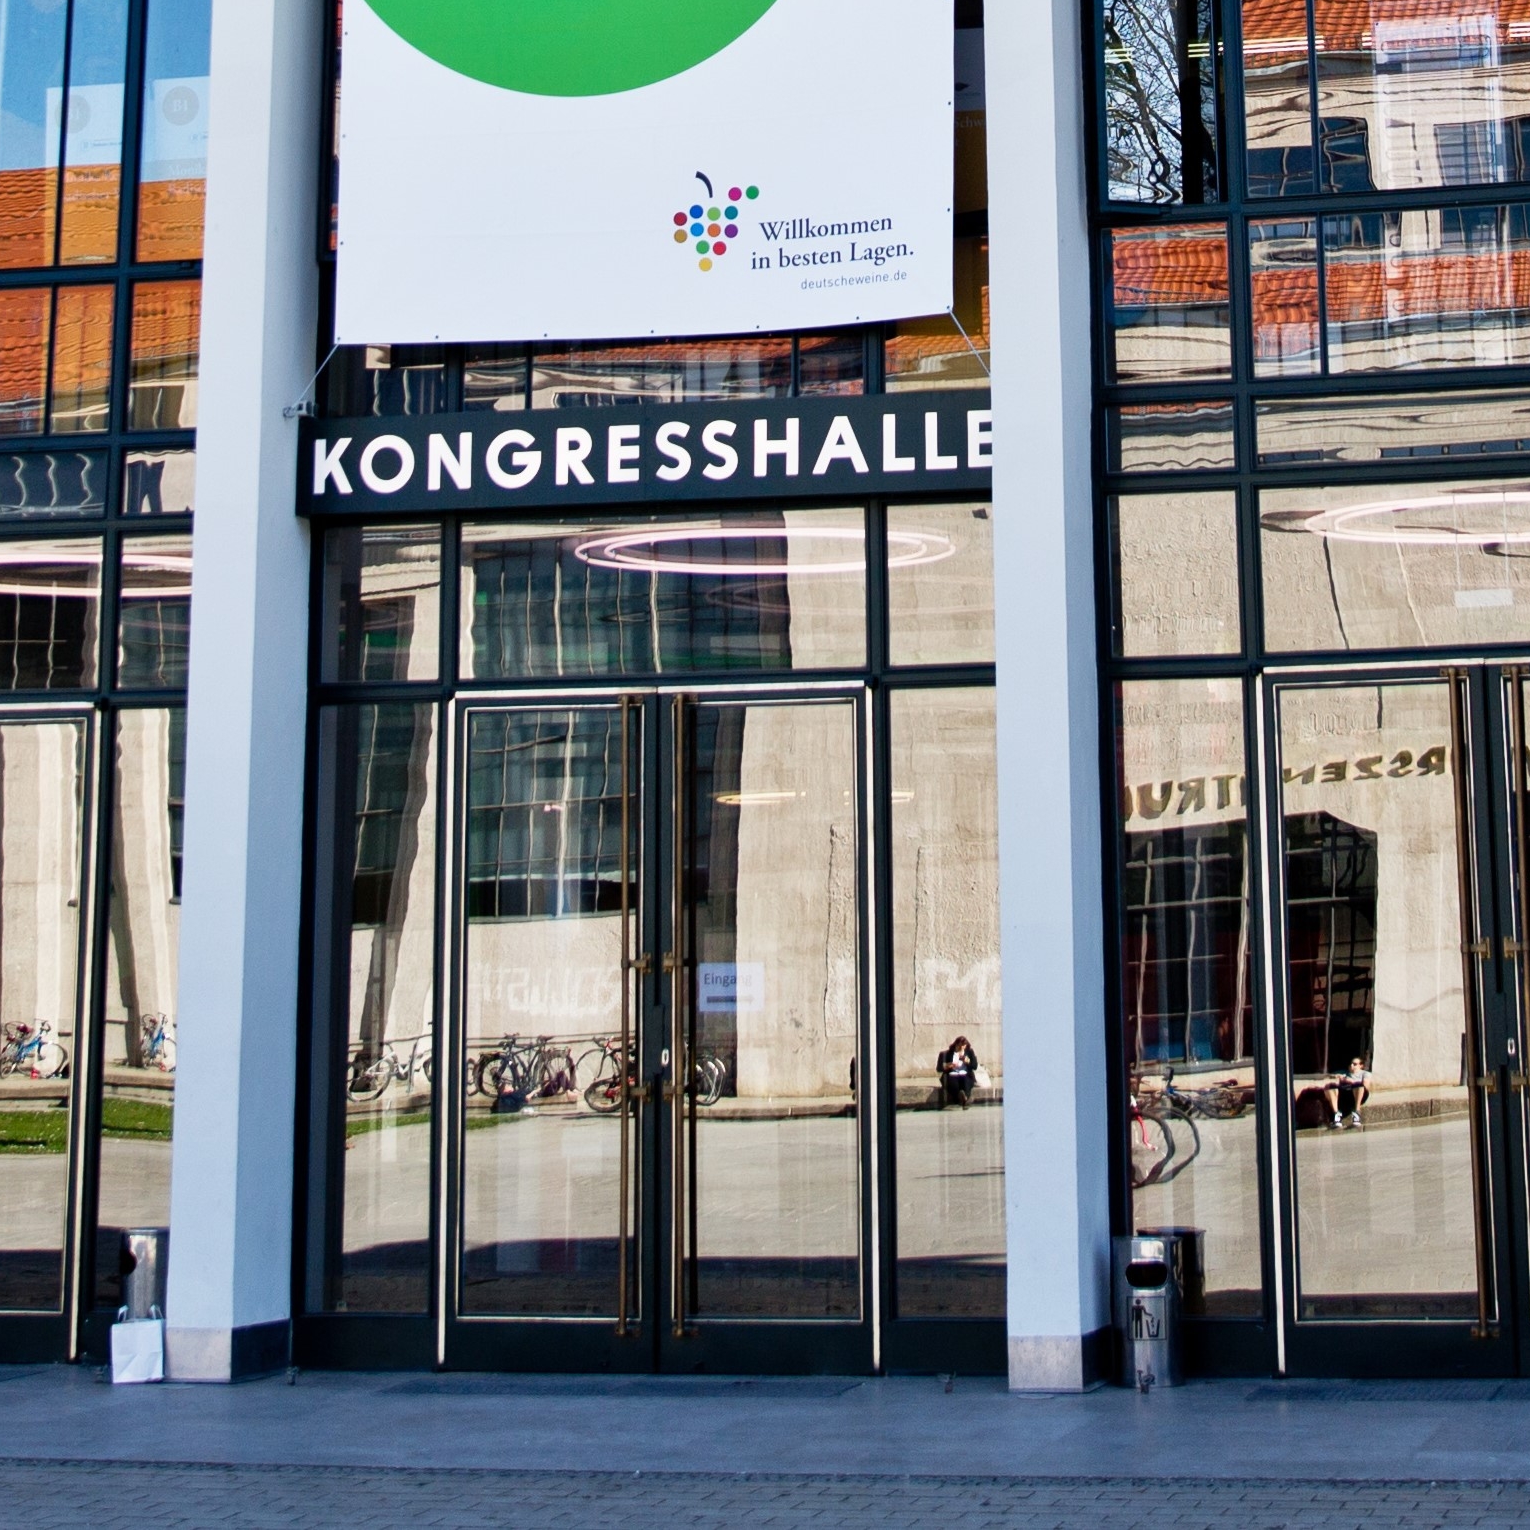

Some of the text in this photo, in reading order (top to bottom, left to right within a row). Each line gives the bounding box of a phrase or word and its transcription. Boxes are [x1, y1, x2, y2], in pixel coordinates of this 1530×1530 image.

[758, 217, 893, 241] Willkommen
[751, 242, 914, 269] in besten Lagen.
[800, 270, 907, 290] deutscheweine.de
[312, 410, 992, 495] KONGRESSHALLE
